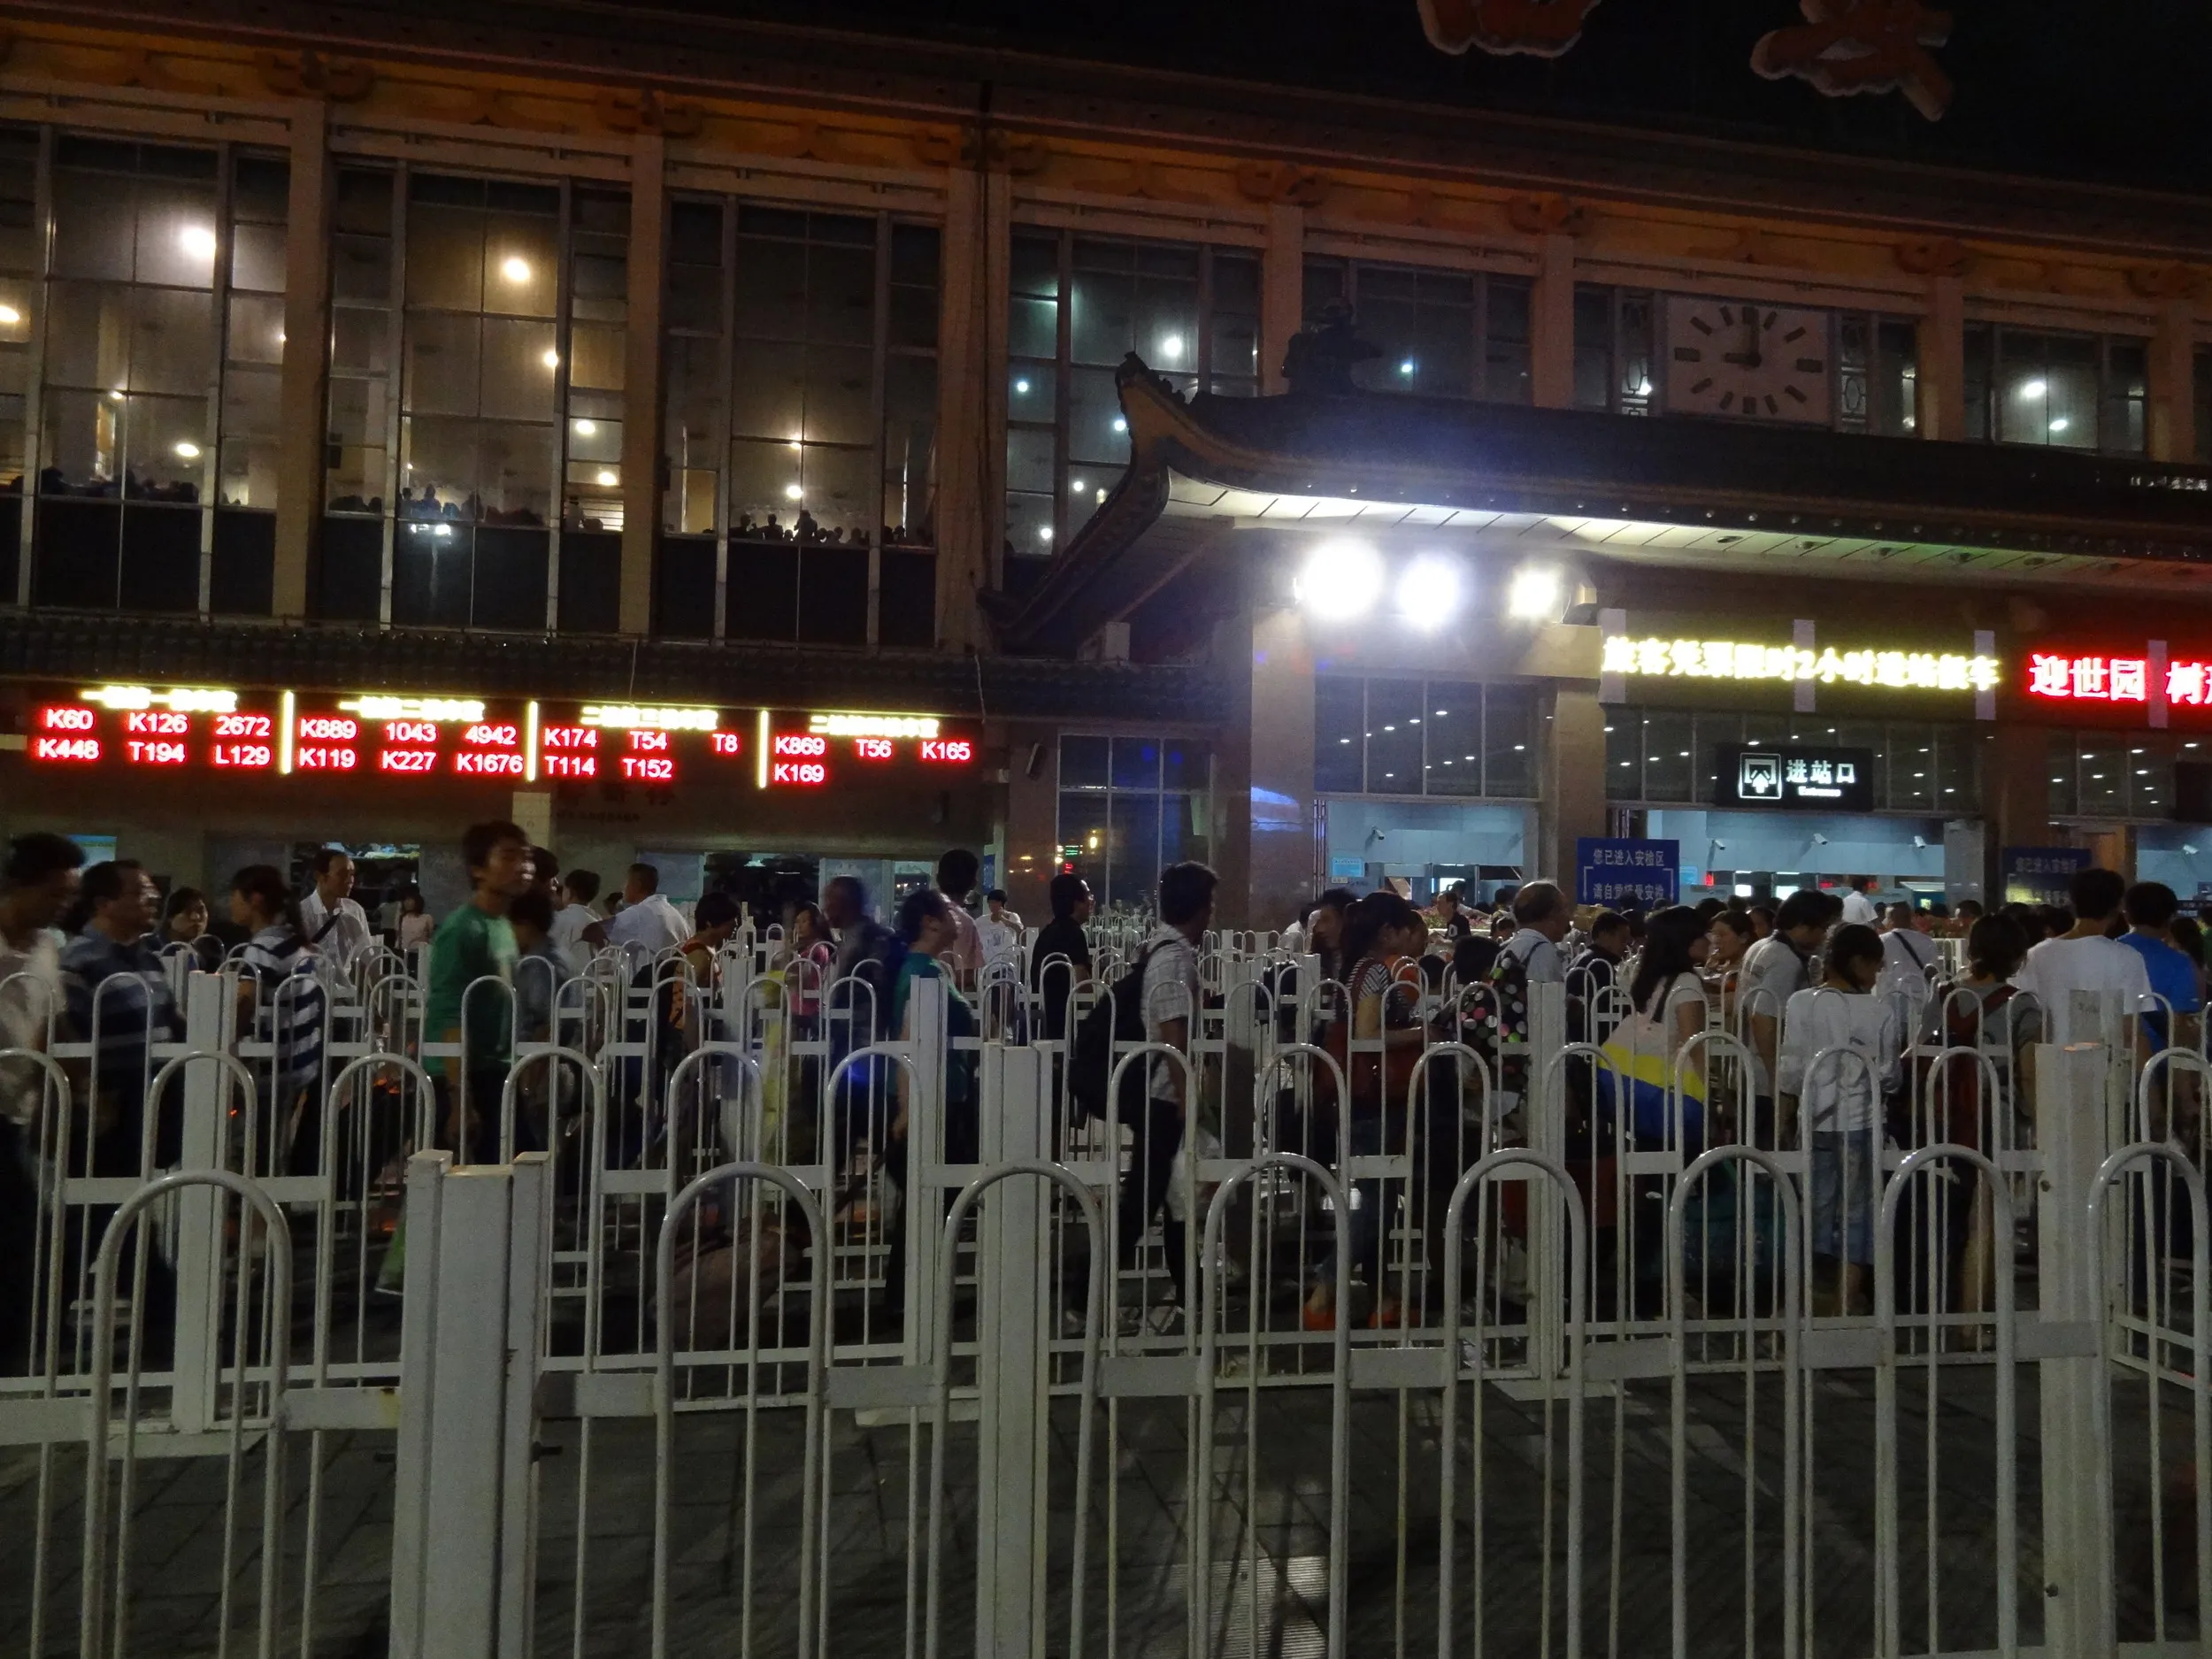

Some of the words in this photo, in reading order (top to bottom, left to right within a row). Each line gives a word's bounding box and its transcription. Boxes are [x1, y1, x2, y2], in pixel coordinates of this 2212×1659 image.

[2028, 653, 2146, 702] 迎世园
[2165, 661, 2212, 704] 树
[45, 708, 94, 730] K60
[128, 712, 188, 734] K126
[215, 715, 271, 737] 2672
[299, 718, 357, 740] K889
[385, 722, 437, 742] 1043
[465, 725, 517, 746] 4942
[38, 738, 100, 760] K448
[127, 741, 186, 763] T194
[215, 744, 271, 766] L129
[543, 727, 598, 748] K174
[628, 731, 668, 750] T54
[711, 733, 739, 753] T8
[774, 735, 826, 756] K869
[855, 739, 892, 758] T56
[921, 741, 971, 761] K165
[298, 748, 357, 769] K119
[381, 749, 437, 771] K227
[457, 752, 525, 774] K1676
[543, 755, 596, 776] T114
[622, 757, 673, 779] T152
[773, 763, 825, 783] K169
[1786, 759, 1855, 785] 进站口
